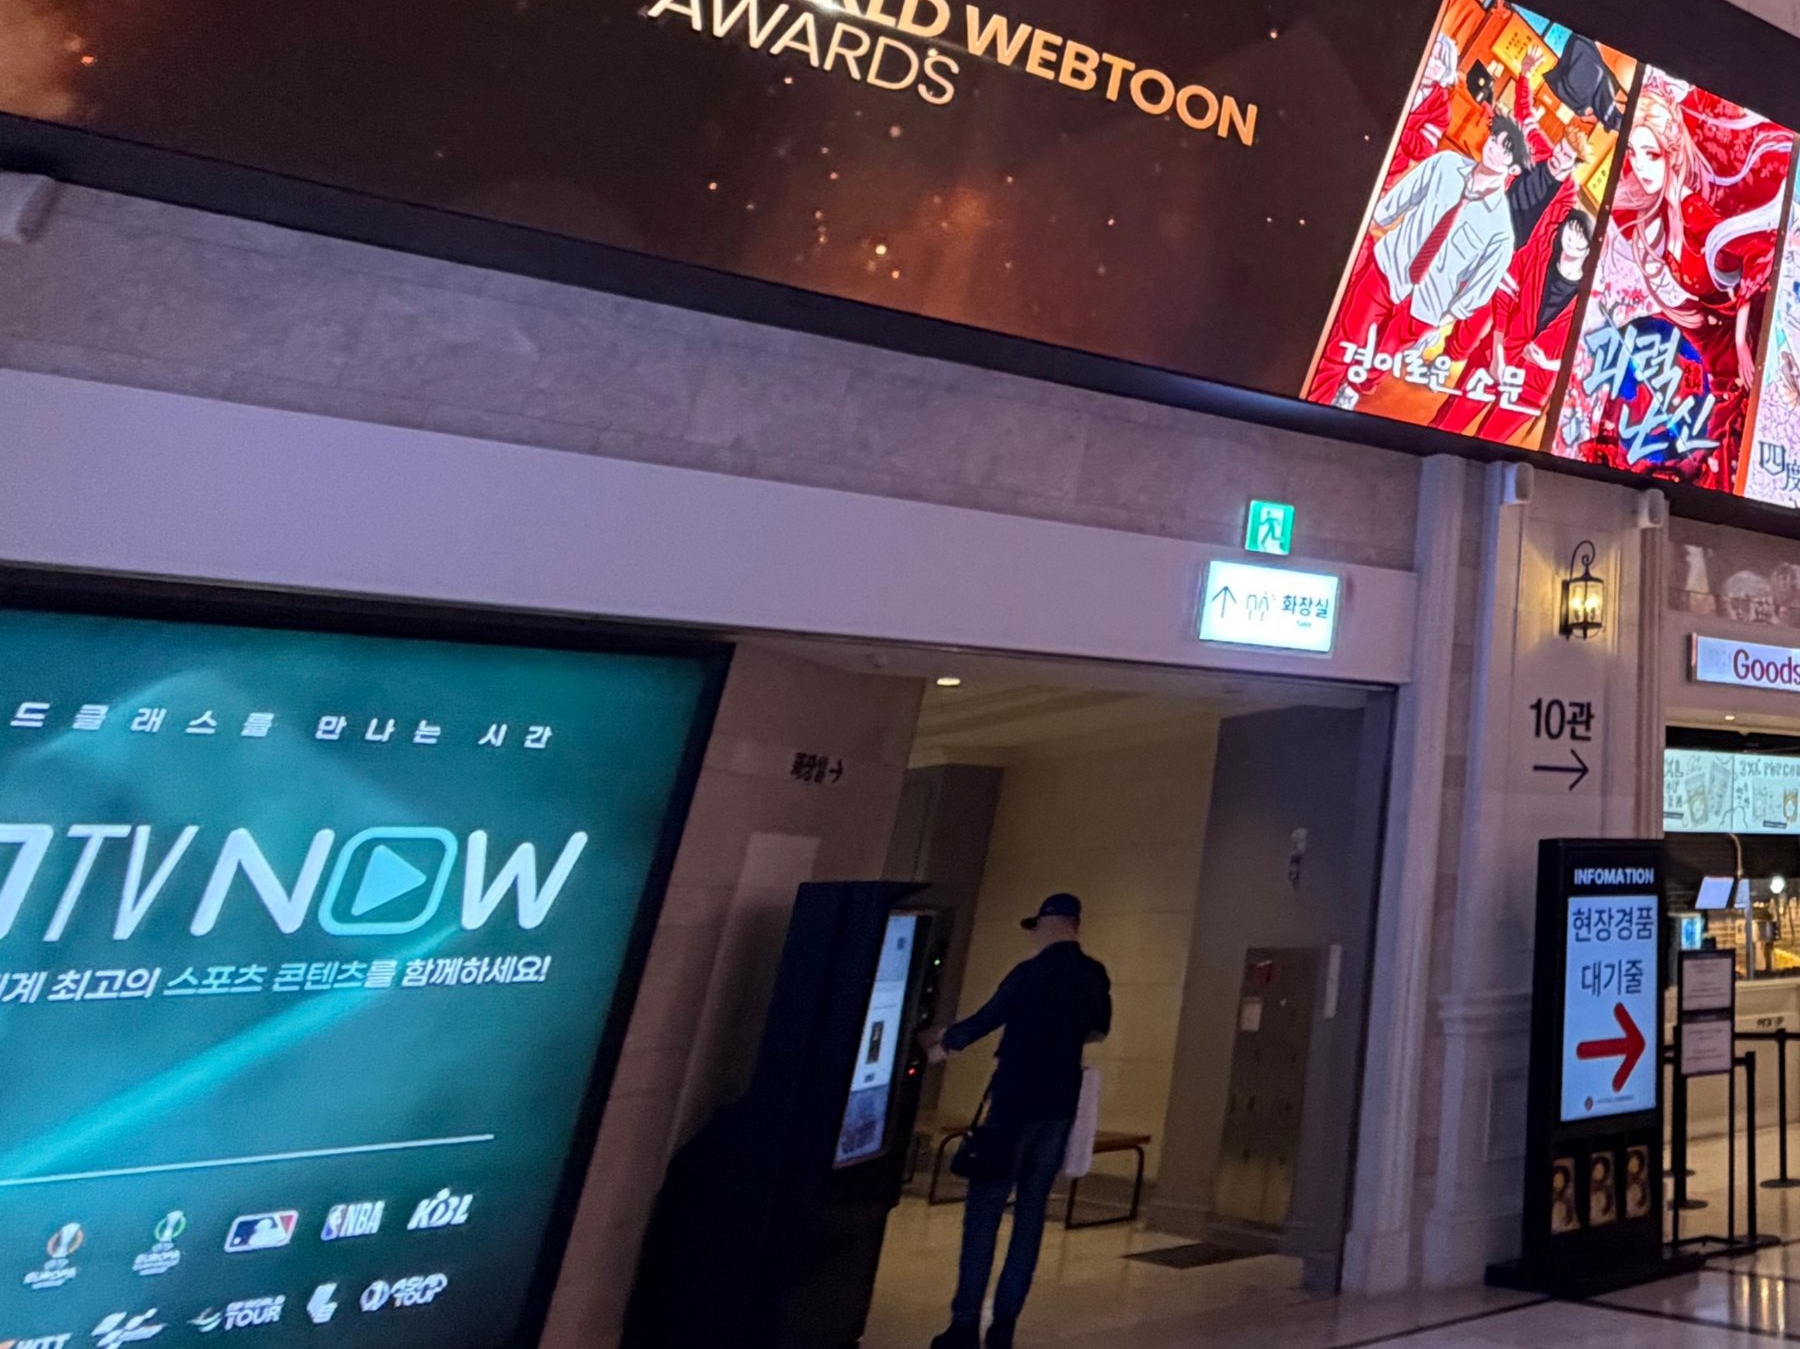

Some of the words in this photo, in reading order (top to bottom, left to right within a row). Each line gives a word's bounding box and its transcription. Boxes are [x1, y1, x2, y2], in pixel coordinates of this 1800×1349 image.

[965, 5, 1259, 147] WEBTOON
[1339, 323, 1463, 397] 경이로운
[1465, 344, 1542, 417] 소문
[1282, 594, 1329, 620] 화장실
[1529, 698, 1595, 742] 10관
[1574, 868, 1655, 886] INFOMATION
[1571, 906, 1655, 943] 현장경품
[47, 967, 162, 1001] 최고의
[163, 963, 268, 996] 스포츠
[272, 956, 398, 992] 콘텐츠를
[401, 954, 552, 989] 함께하세요!
[1581, 958, 1644, 998] 대기줄
[338, 1200, 386, 1238] NBA
[406, 1188, 474, 1231] KBL
[223, 1303, 285, 1331] TOUR
